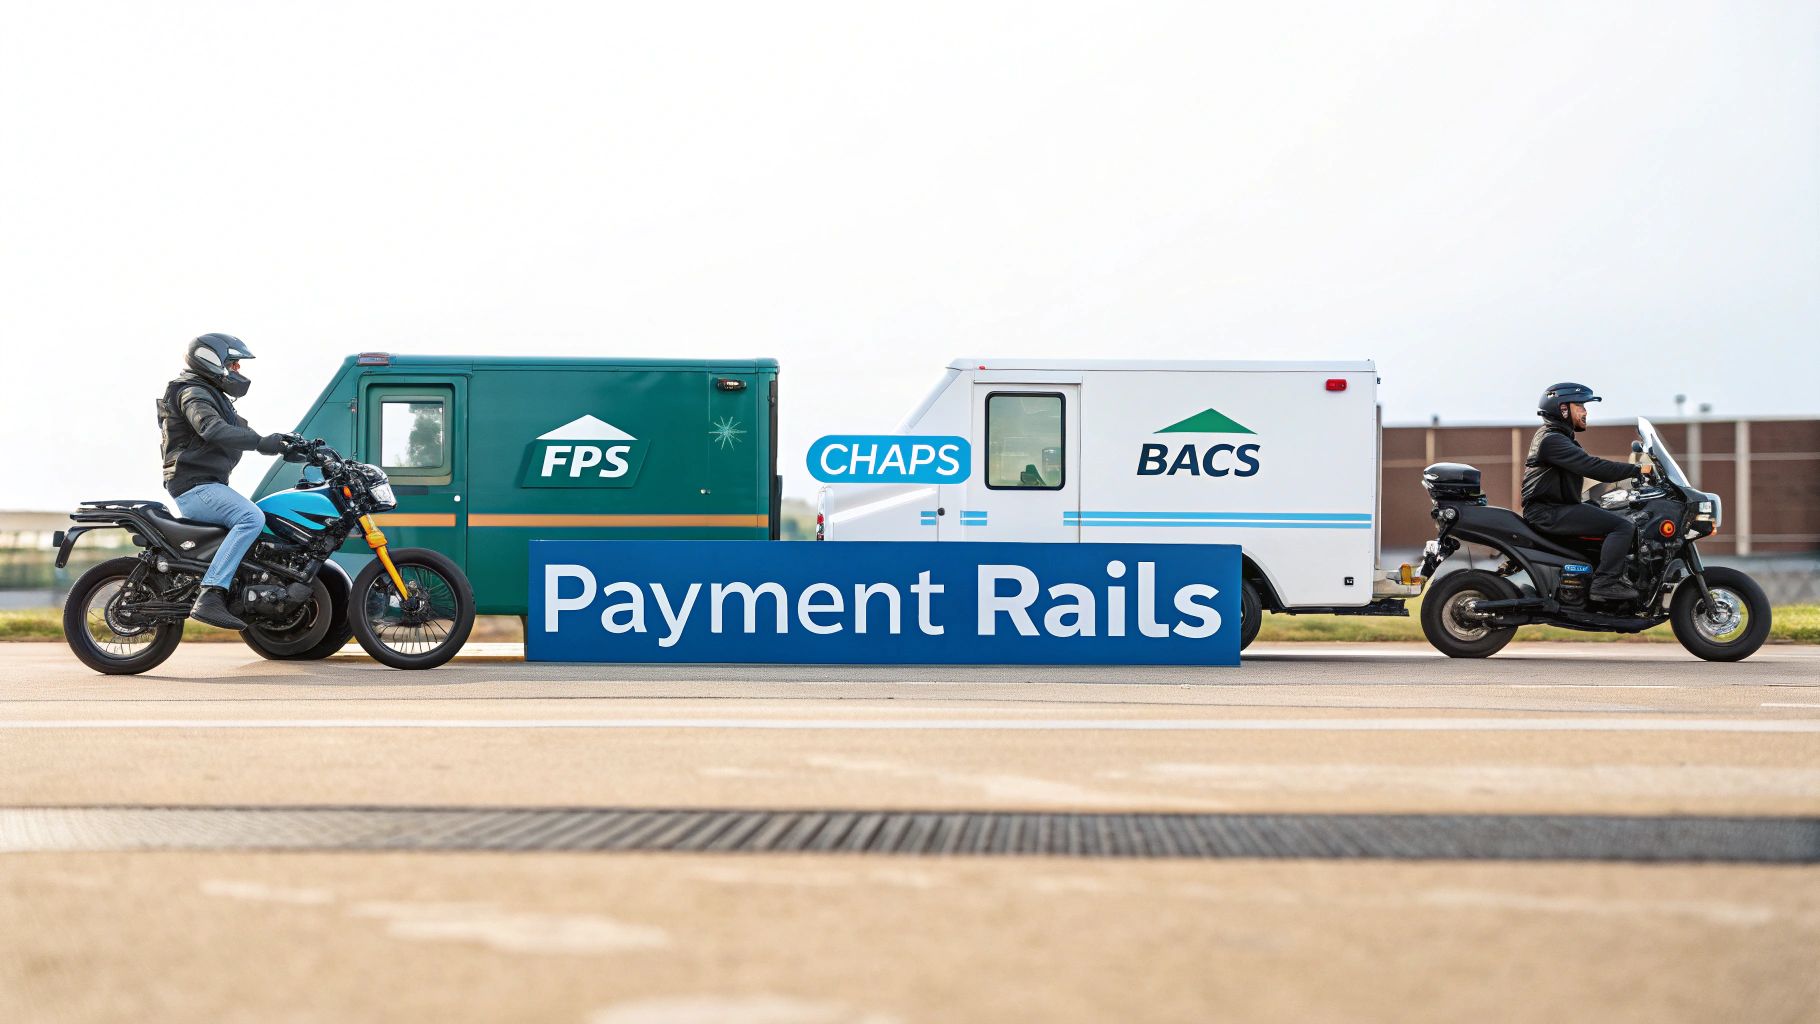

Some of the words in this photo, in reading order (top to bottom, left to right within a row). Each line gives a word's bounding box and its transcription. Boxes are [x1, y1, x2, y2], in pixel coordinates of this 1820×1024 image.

[541, 445, 631, 478] FPS
[820, 443, 960, 476] CHAPS
[1137, 443, 1261, 477] BACS
[544, 564, 945, 648] Payment
[977, 559, 1222, 639] Rails
